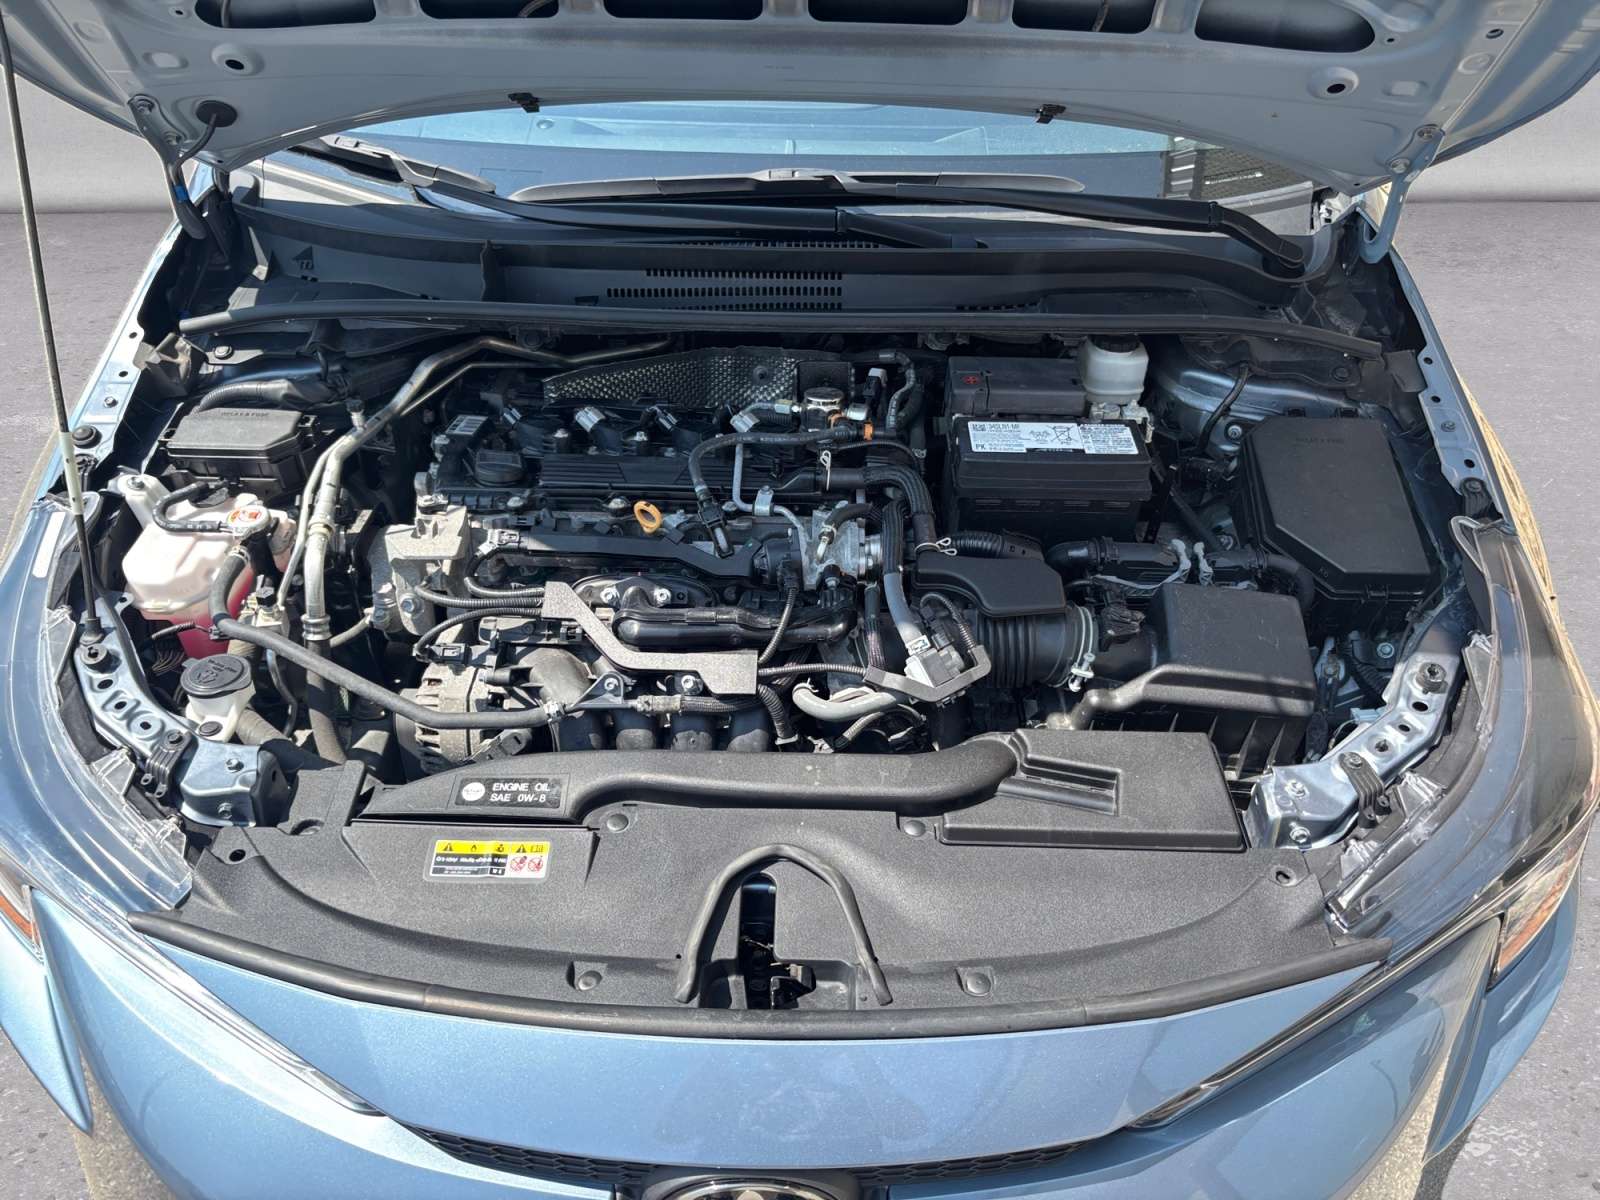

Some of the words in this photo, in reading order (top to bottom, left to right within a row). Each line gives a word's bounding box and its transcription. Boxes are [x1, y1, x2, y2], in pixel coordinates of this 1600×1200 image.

[492, 782, 529, 792] ENGINE
[534, 782, 551, 792] OIL
[490, 792, 512, 802] SAE
